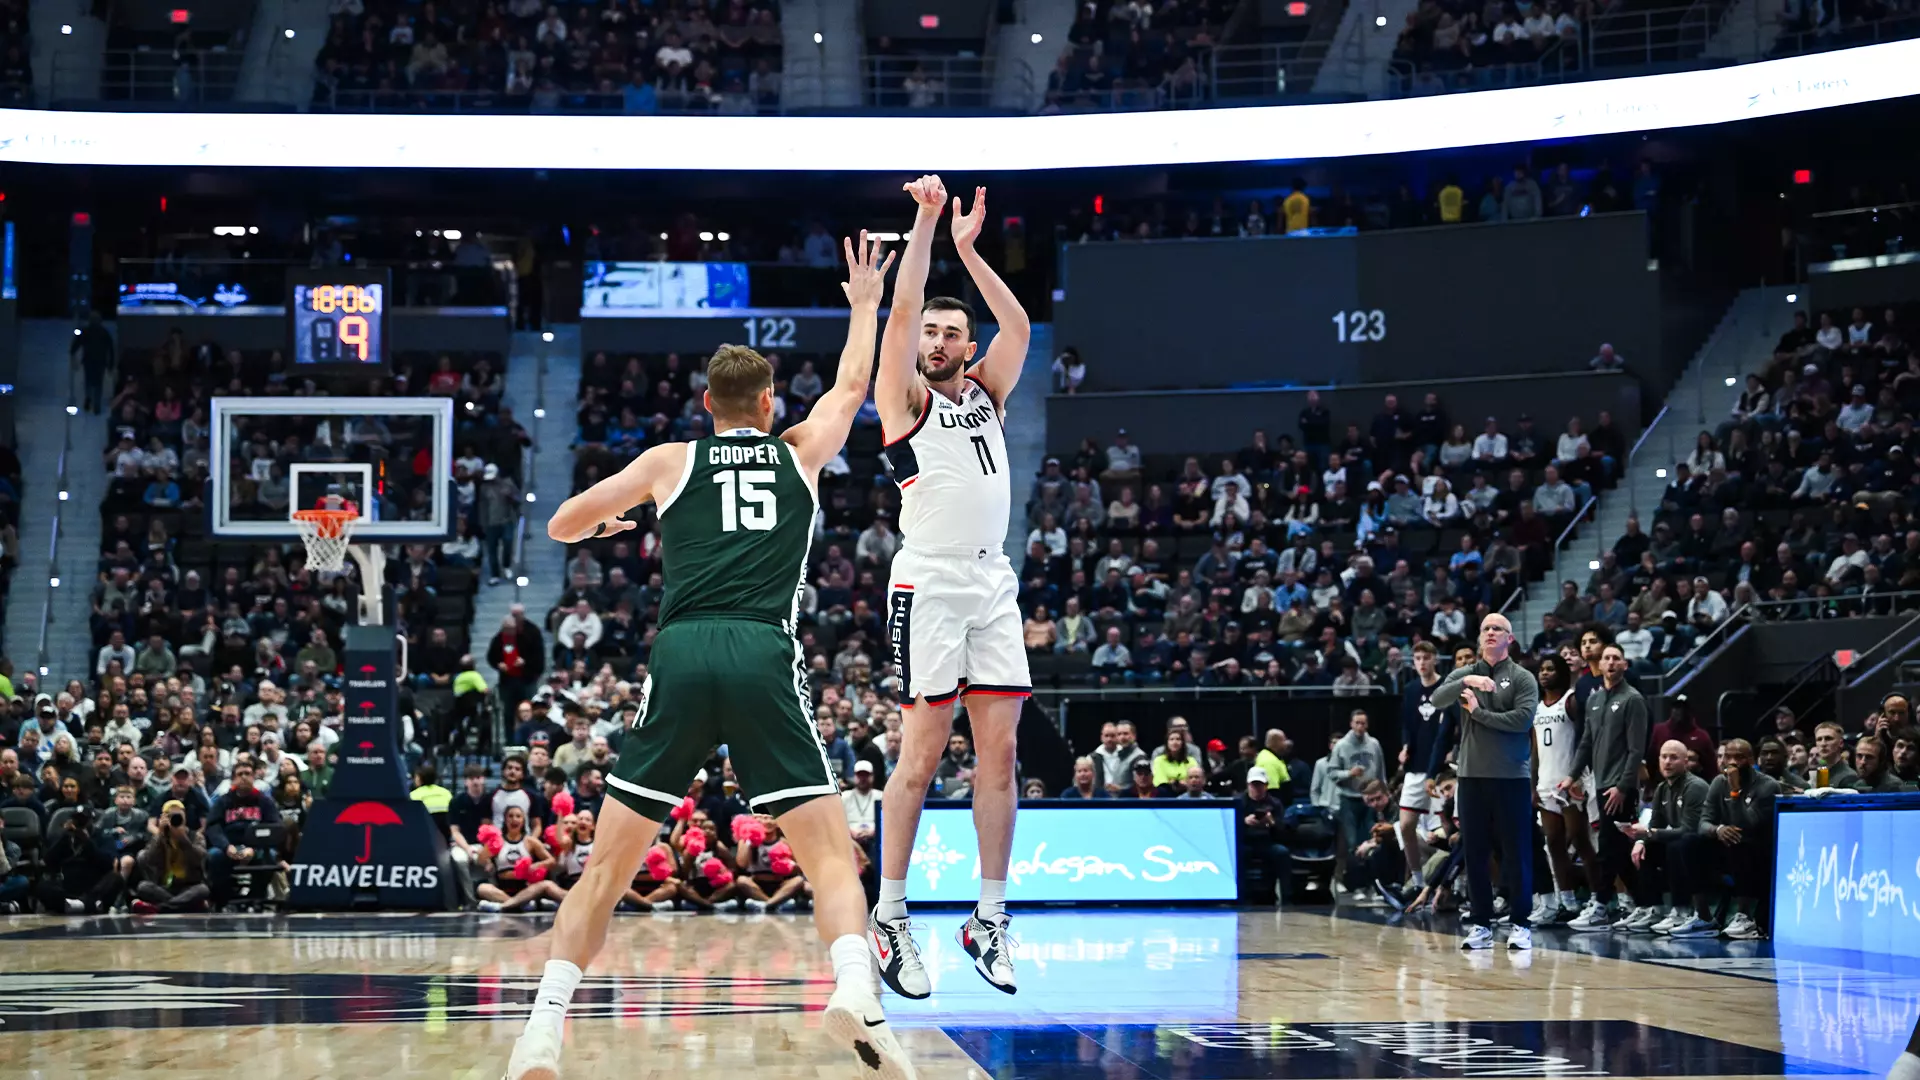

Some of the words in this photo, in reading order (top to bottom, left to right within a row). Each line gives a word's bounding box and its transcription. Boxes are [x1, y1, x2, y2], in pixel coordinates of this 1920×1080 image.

[312, 285, 375, 313] 18:06
[339, 316, 369, 361] 9
[743, 318, 796, 347] 122
[1332, 309, 1386, 342] 123
[709, 443, 781, 465] COOPER
[970, 435, 997, 475] 11
[713, 470, 777, 532] 15
[892, 596, 906, 692] HUSKIES
[1544, 728, 1552, 746] 0
[291, 864, 438, 888] TRAVELERS
[1142, 845, 1219, 882] Sun
[1813, 841, 1908, 921] Mohegan
